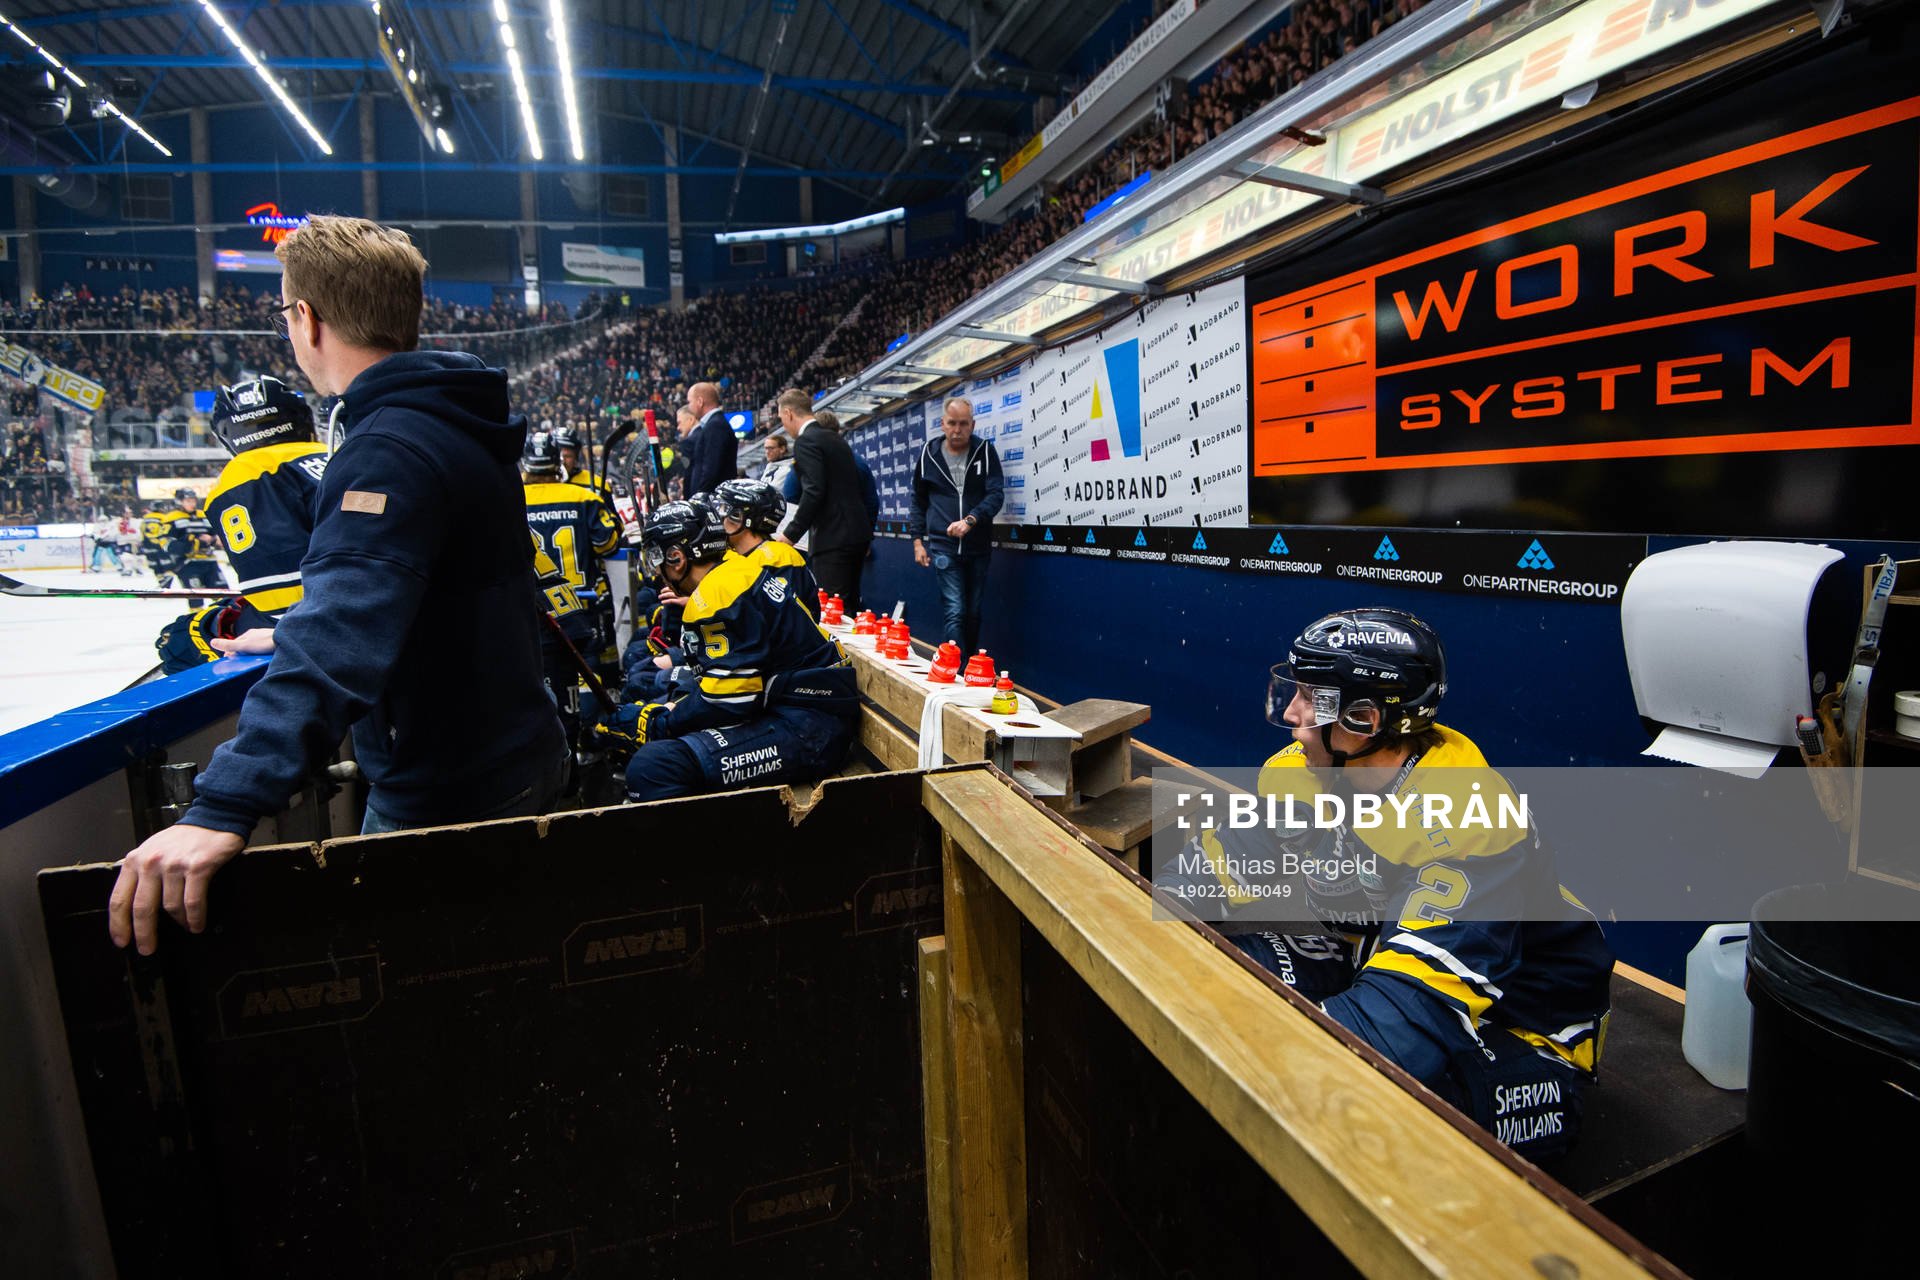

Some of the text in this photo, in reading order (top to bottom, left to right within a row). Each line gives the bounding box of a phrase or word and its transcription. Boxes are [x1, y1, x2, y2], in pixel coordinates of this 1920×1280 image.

[1381, 60, 1524, 155] HOLST
[1393, 164, 1879, 340] WORK
[1200, 301, 1240, 332] ADDBRAND
[1147, 322, 1179, 350] ADDBRAND
[1200, 342, 1240, 371] ADDBRAND
[1148, 360, 1179, 385] ADDBRAND
[1400, 336, 1851, 430] SYSTEM
[47, 367, 98, 404] TIFO
[1201, 384, 1241, 409] ADDBRAND
[231, 406, 278, 423] Husqvarna
[1149, 397, 1180, 420] ADDBRAND
[1150, 433, 1181, 454] ADDBRAND
[1202, 424, 1242, 448] ADDBRAND
[1203, 465, 1242, 486] ADDBRAND
[1075, 475, 1167, 501] ADDBRAND
[527, 508, 578, 522] sqvarna
[1109, 507, 1136, 522] ADDBRAND
[1152, 506, 1183, 523] ADDBRAND
[1204, 505, 1243, 523] ADDBRAND
[220, 504, 256, 554] 8
[692, 547, 701, 558] 5
[1071, 545, 1111, 556] ONEPARTNERGROUP
[1117, 549, 1167, 561] ONEPARTNERGROUP
[1171, 553, 1230, 567] ONEPARTNERGROUP
[1240, 558, 1322, 574] ONEPARTNERGROUP
[1336, 565, 1443, 584] ONEPARTNERGROUP
[1463, 574, 1618, 599] ONEPARTNERGROUP
[700, 622, 729, 659] 5
[1348, 632, 1412, 645] RAVEMA
[1401, 718, 1411, 734] 2
[720, 745, 779, 771] SHERWIN
[722, 758, 782, 785] WILLIAMS
[1397, 862, 1472, 932] 2
[240, 976, 361, 1018] RAW
